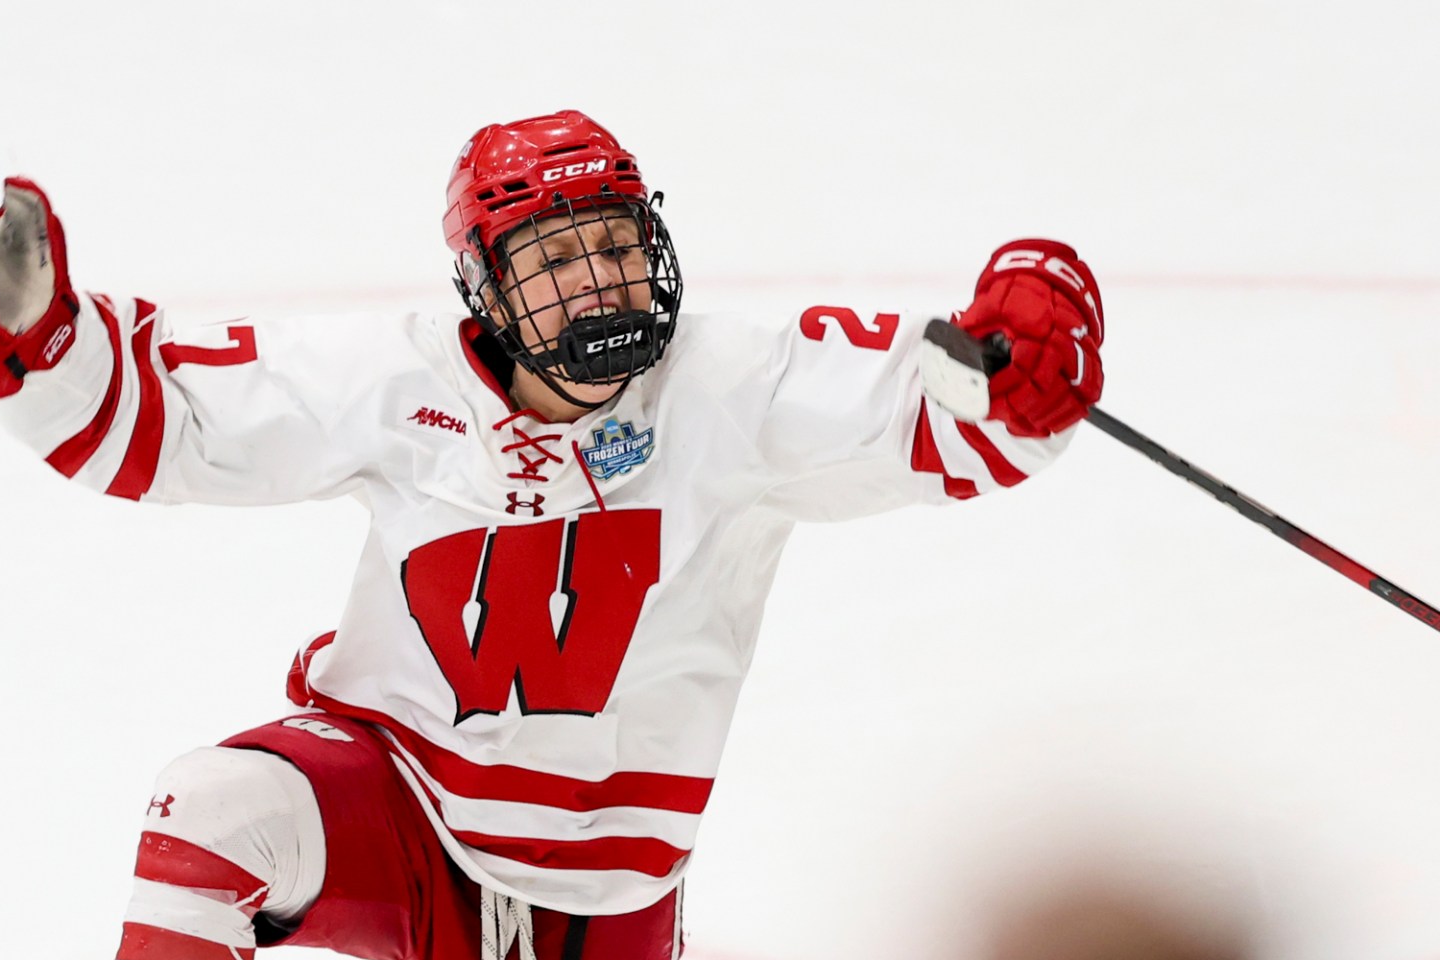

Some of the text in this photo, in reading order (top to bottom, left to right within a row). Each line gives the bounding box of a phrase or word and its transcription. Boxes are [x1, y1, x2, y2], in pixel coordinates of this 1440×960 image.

[541, 159, 607, 183] CCM
[586, 329, 643, 354] CCM
[799, 305, 900, 351] 2
[588, 446, 625, 464] FROZEN
[626, 434, 650, 452] FOUR
[400, 508, 662, 727] W
